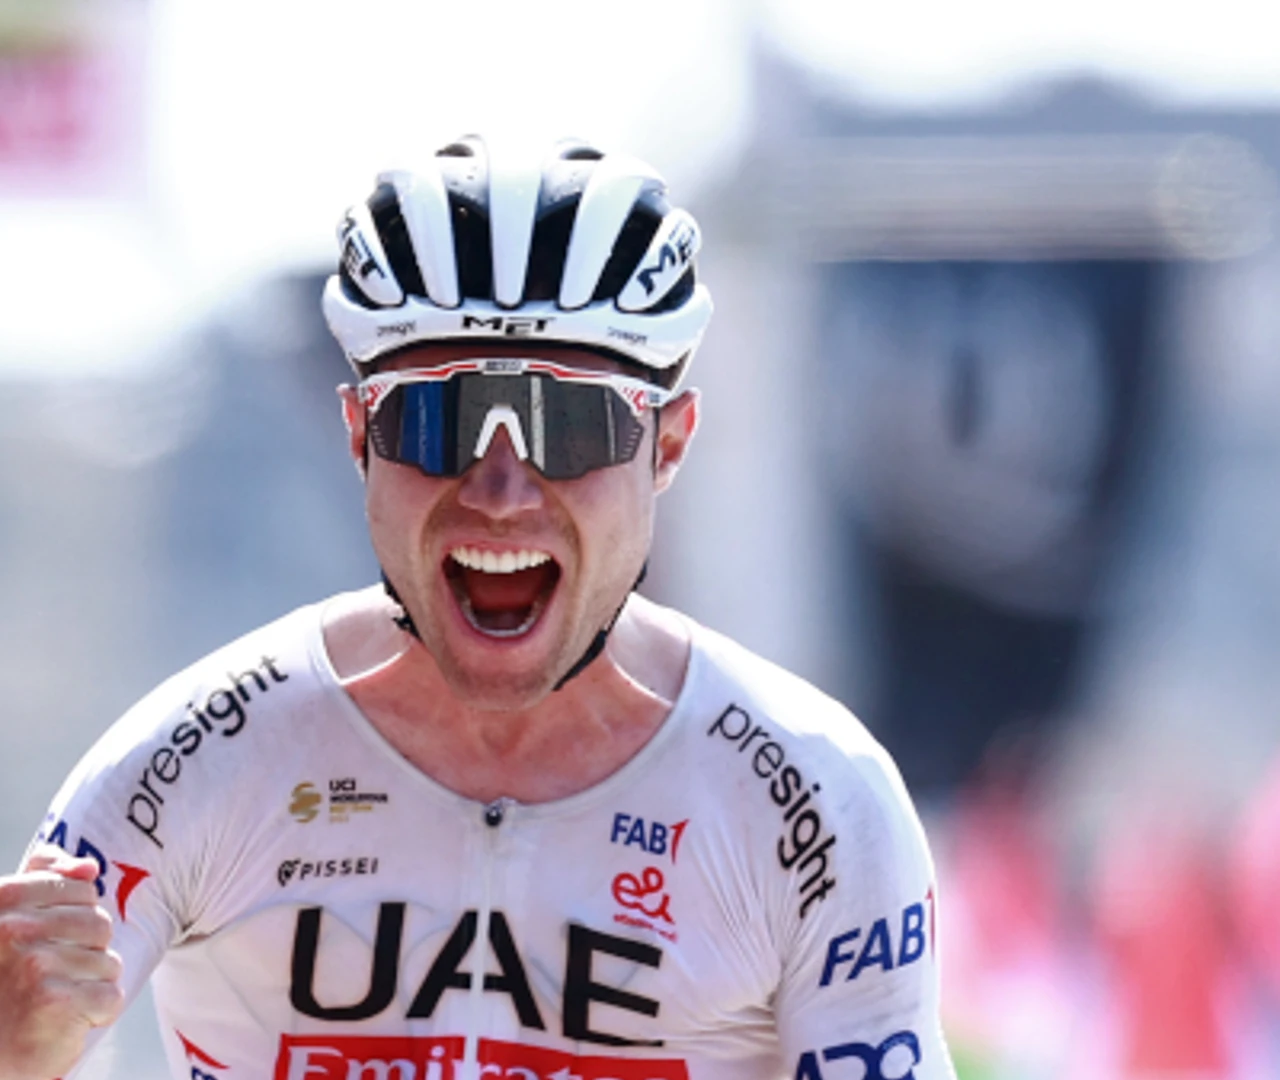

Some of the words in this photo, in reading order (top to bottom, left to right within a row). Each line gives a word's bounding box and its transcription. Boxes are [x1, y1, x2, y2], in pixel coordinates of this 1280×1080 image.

[463, 316, 557, 336] MET
[126, 655, 290, 850] presight
[328, 778, 357, 792] UCI
[707, 702, 837, 919] presight
[299, 857, 379, 881] PISSEI
[288, 901, 664, 1048] UAE
